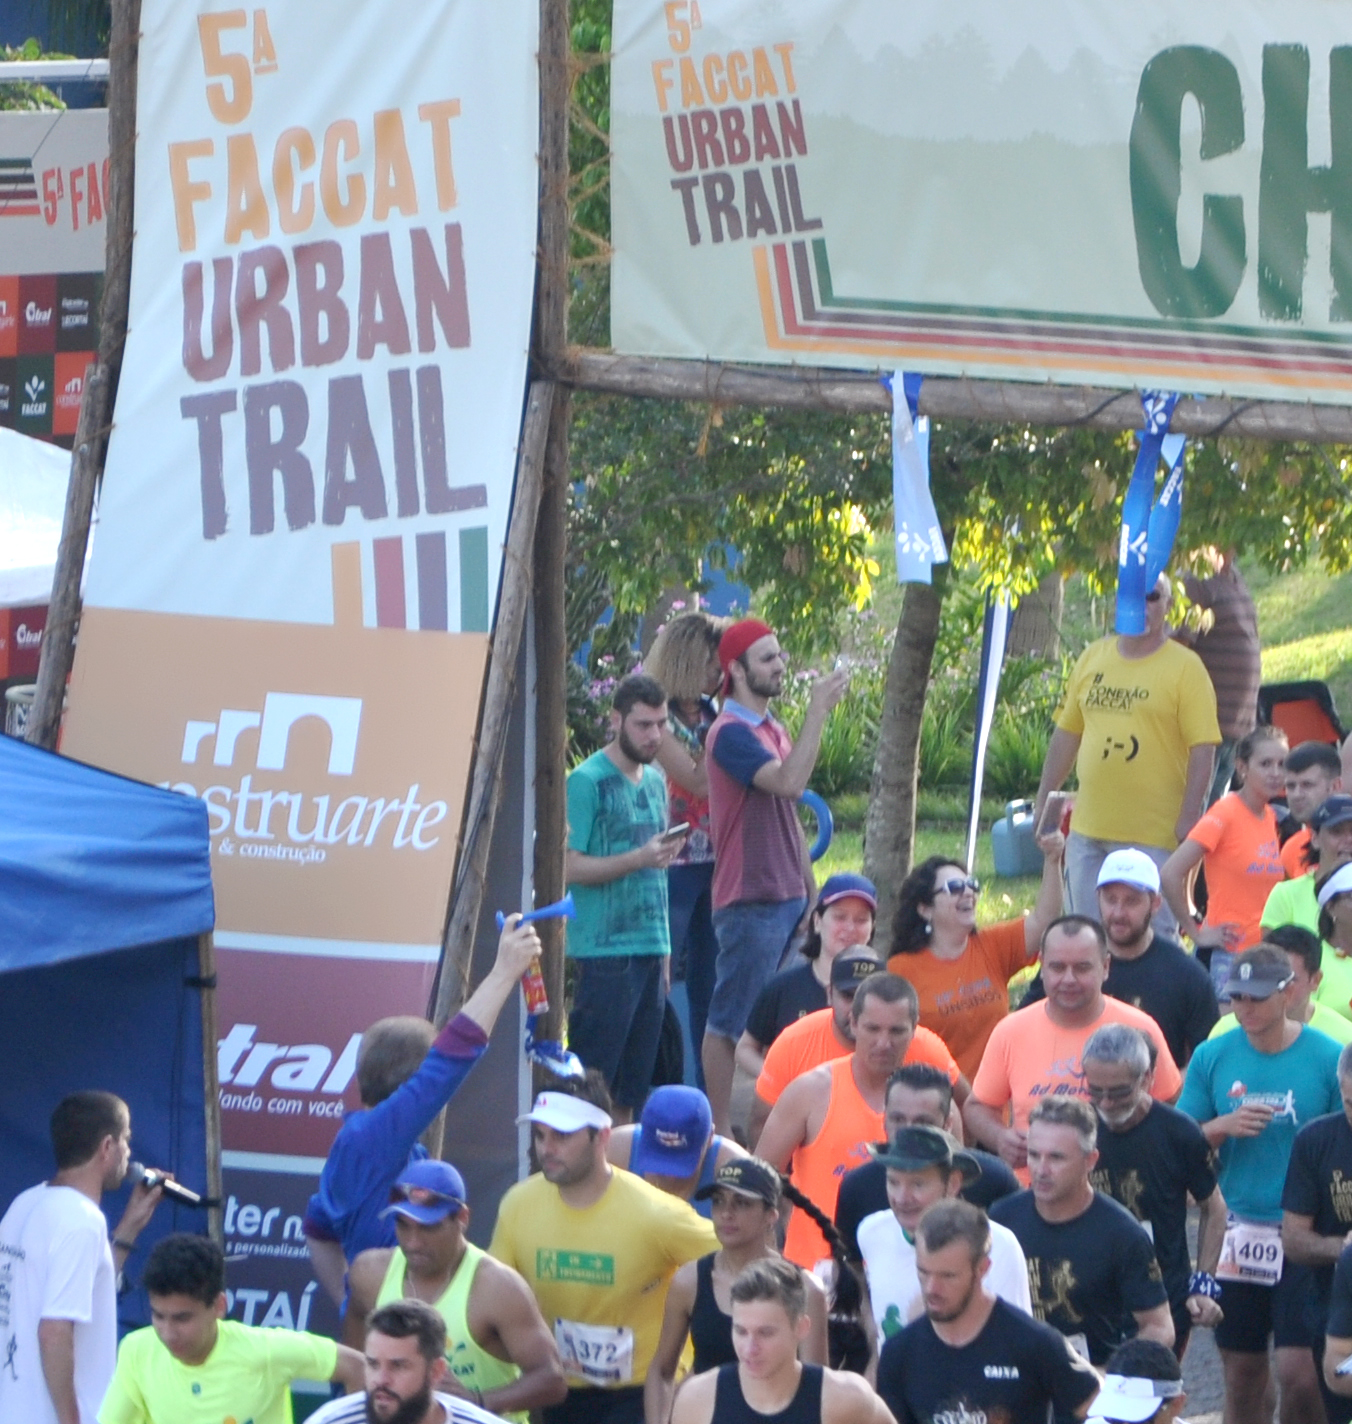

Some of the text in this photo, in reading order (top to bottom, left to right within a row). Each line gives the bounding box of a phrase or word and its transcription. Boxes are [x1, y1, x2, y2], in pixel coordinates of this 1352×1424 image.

[652, 41, 797, 112] FACCAT
[661, 98, 808, 172] URBAN
[167, 98, 460, 252] FACCAT
[671, 164, 823, 246] TRAIL
[180, 221, 470, 383] URBAN
[180, 364, 488, 540] TRAIL
[219, 837, 326, 865] & construção
[267, 1096, 302, 1115] com
[308, 1098, 344, 1118] você
[1239, 1243, 1277, 1262] 409
[579, 1340, 618, 1363] 372
[984, 1365, 1020, 1379] CAIXA
